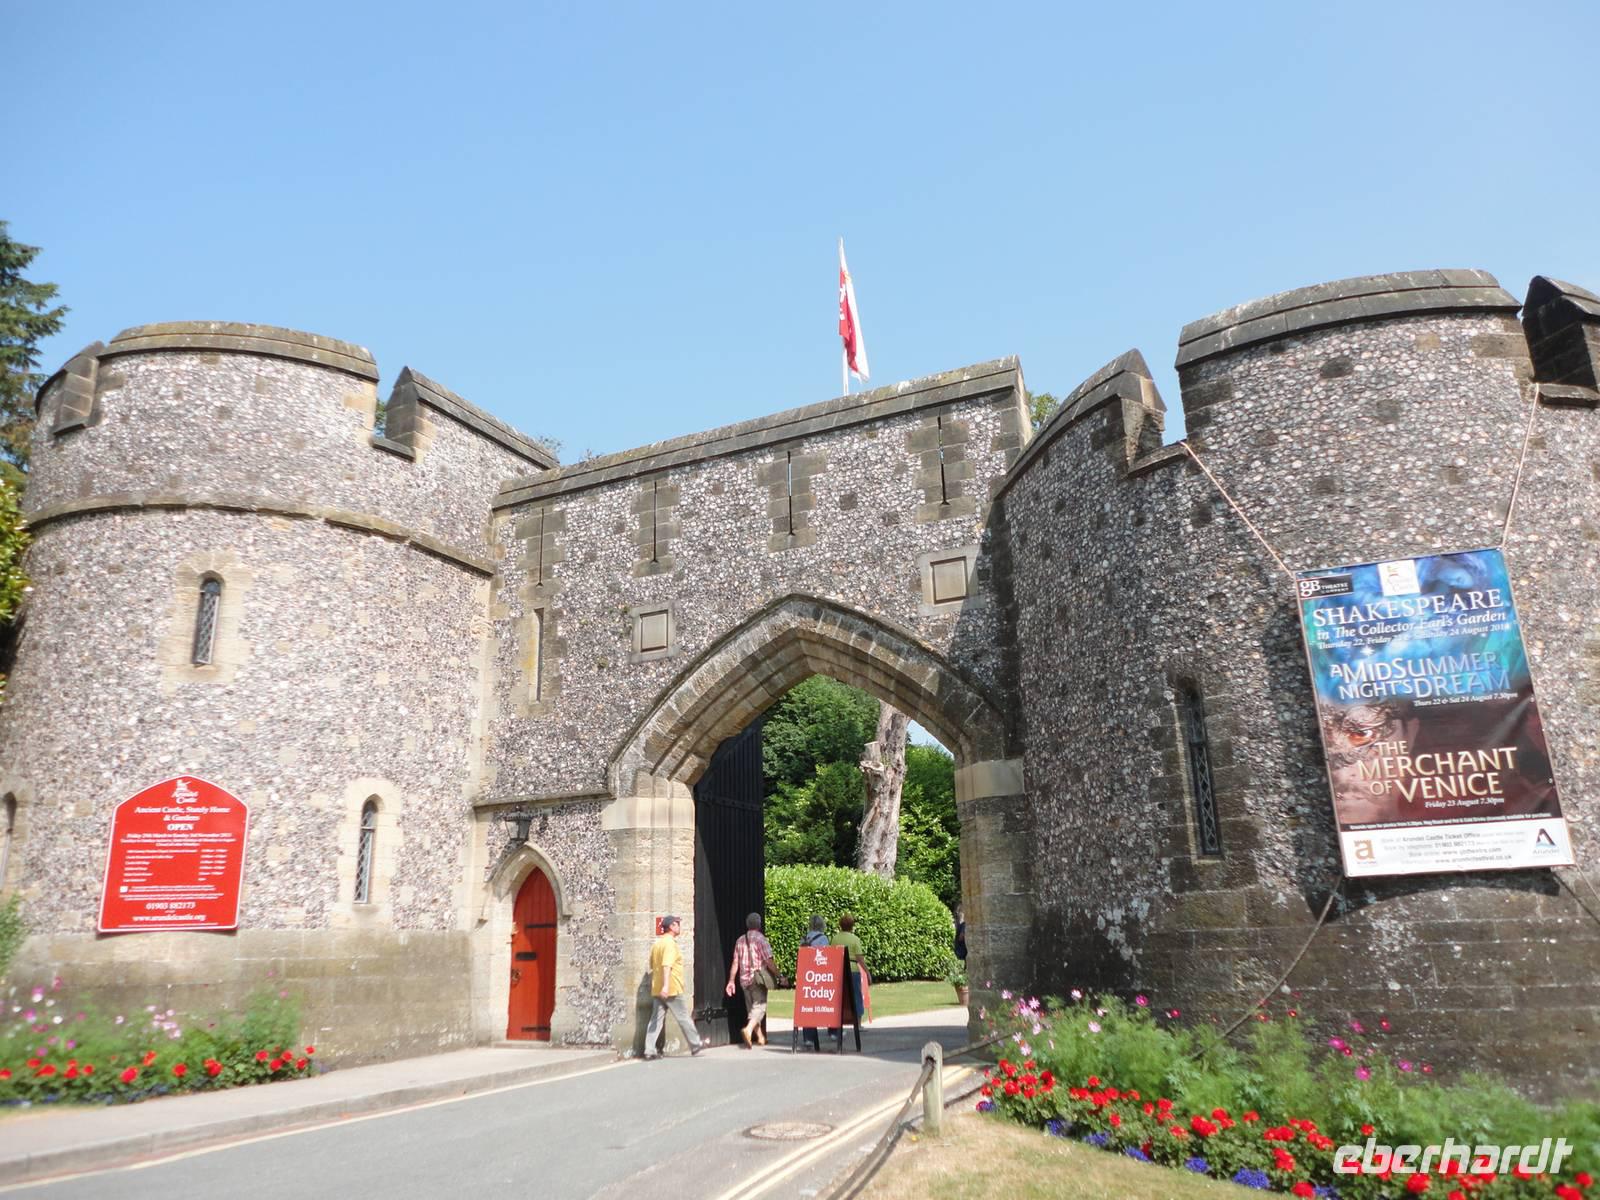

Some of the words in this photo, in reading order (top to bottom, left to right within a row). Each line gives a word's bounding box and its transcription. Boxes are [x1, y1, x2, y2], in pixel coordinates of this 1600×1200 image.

[1321, 582, 1348, 590] THEATRE
[1312, 588, 1504, 627] SHAKESPEARE
[1317, 630, 1329, 640] in
[1336, 626, 1356, 638] The
[1359, 622, 1415, 636] Collector
[1419, 614, 1453, 628] Earl's
[1457, 610, 1506, 625] Garden
[1319, 640, 1352, 649] Thursday
[1367, 635, 1392, 645] Friday
[1461, 625, 1488, 637] August
[1329, 664, 1343, 678] A
[1342, 652, 1501, 684] MIDSUMMER
[1338, 679, 1414, 700] NIGHT'S
[1413, 670, 1511, 698] DREAM
[1413, 699, 1432, 707] Thurs
[1470, 694, 1492, 703] August
[1493, 692, 1518, 701] 7.30pm
[1375, 741, 1409, 756] THE
[1356, 746, 1517, 780] MERCHANT
[1369, 780, 1393, 796] OF
[1394, 773, 1503, 803] VENICE
[1424, 800, 1446, 809] Friday
[1457, 798, 1479, 808] August
[1480, 797, 1505, 806] 7.30pm
[166, 823, 194, 831] OPEN
[805, 970, 833, 985] Open
[803, 986, 835, 1001] Today
[801, 1005, 813, 1013] from
